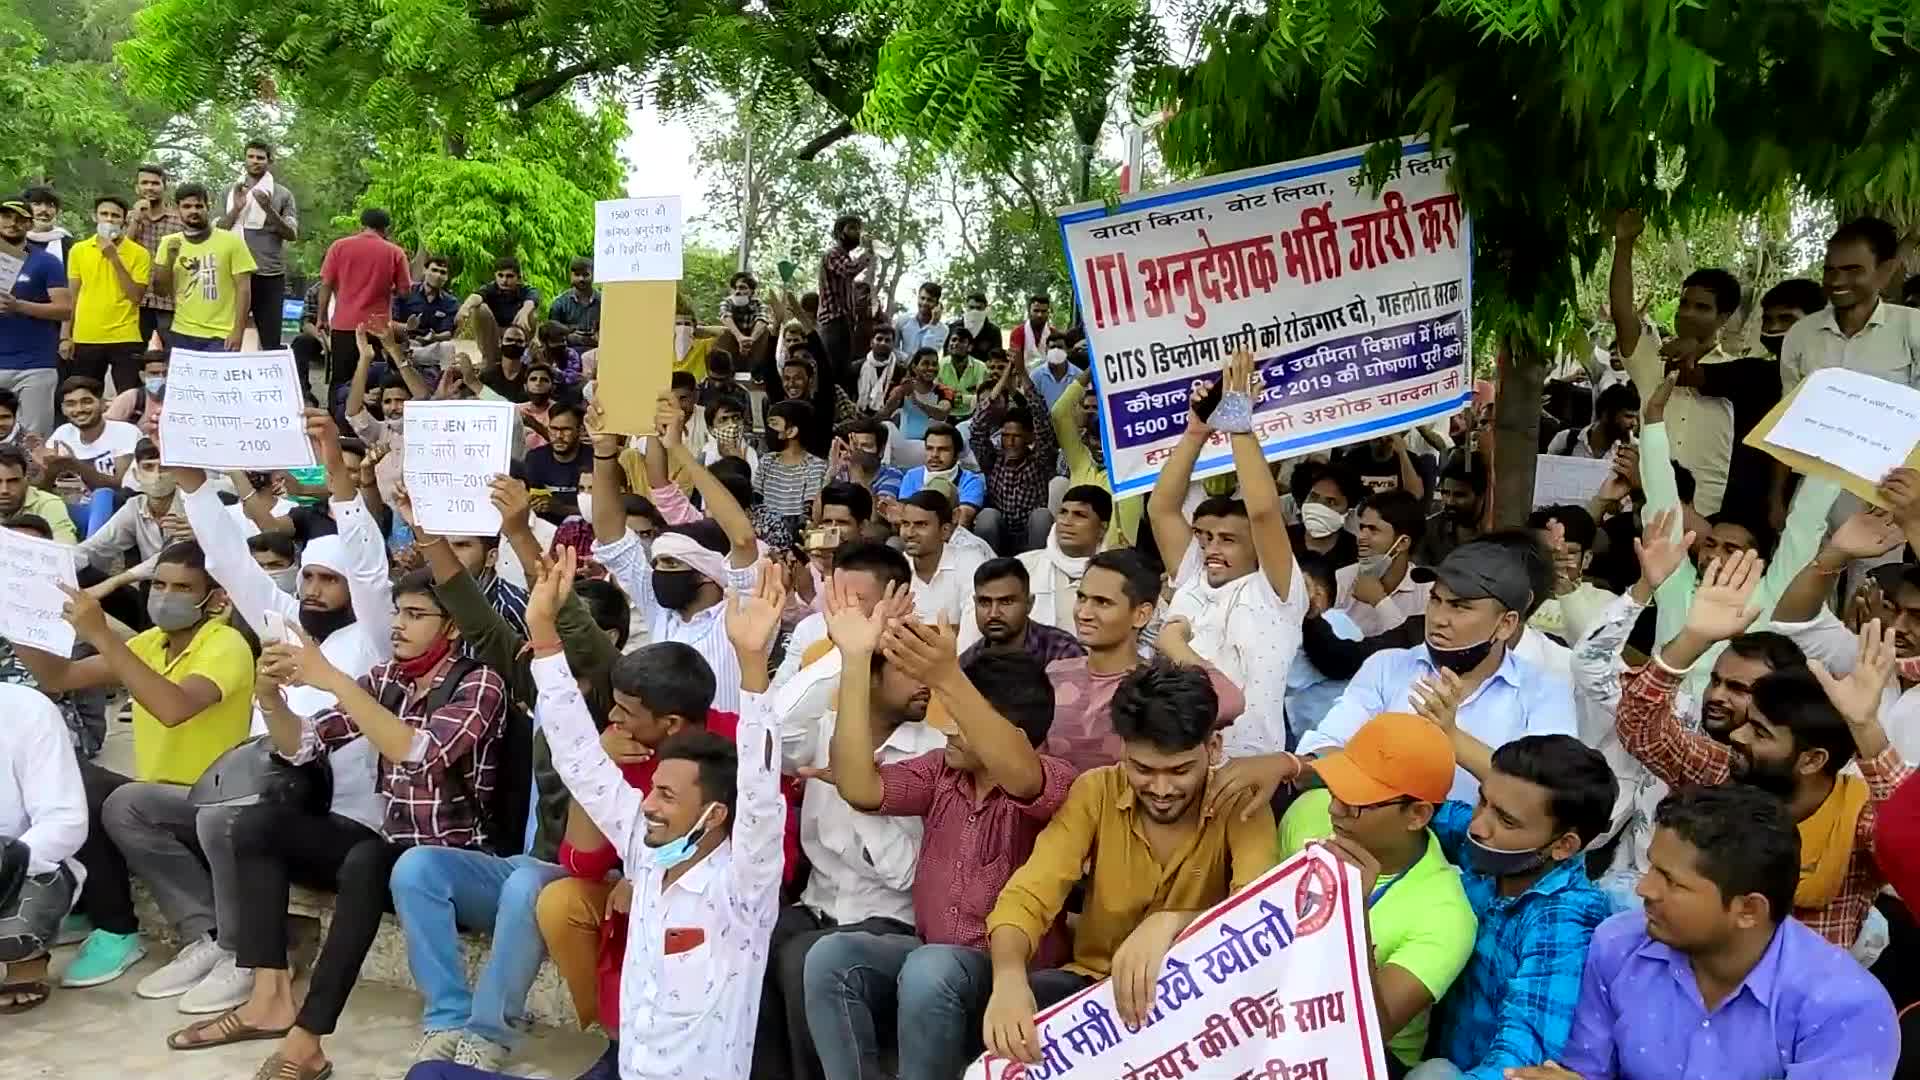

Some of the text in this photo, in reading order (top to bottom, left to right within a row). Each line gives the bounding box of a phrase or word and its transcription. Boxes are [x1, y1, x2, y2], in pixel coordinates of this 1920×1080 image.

[610, 209, 630, 220] 1500
[1089, 219, 1143, 240] वादा
[1147, 205, 1213, 229] किया,
[1225, 193, 1268, 213] वोट
[1273, 182, 1335, 202] लिया,
[1407, 155, 1452, 177] दिया
[1085, 253, 1137, 329] ITI
[1137, 228, 1279, 330] अनुदेशक
[1341, 191, 1416, 271] जारी
[1104, 348, 1148, 384] CITS
[1150, 334, 1221, 375] डिप्लोमा
[1258, 315, 1282, 349] को
[1283, 312, 1348, 345] रोजगार
[1347, 294, 1376, 327] दो,
[1377, 282, 1432, 318] गहलोत
[223, 369, 252, 382] JEN
[1123, 416, 1168, 438] 1500
[1288, 374, 1332, 396] 2019
[1336, 363, 1360, 383] की
[1364, 358, 1417, 378] घोषणा
[1420, 343, 1441, 371] पूरी
[1443, 339, 1463, 358] करो
[1125, 387, 1187, 413] कौशल
[1270, 363, 1286, 377] व
[1288, 344, 1358, 372] उद्यमिता
[1361, 333, 1416, 357] विभाग
[1419, 322, 1431, 343] में
[1302, 397, 1374, 425] अशोक
[1376, 381, 1440, 407] चान्दना
[1442, 370, 1459, 390] जी
[239, 439, 272, 452] 2100
[442, 419, 466, 433] JEN
[447, 499, 475, 513] 2100
[1062, 1000, 1123, 1057] मंत्री
[1194, 899, 1295, 984] खोलो
[1192, 1013, 1241, 1058] की
[1289, 990, 1347, 1032] साथ
